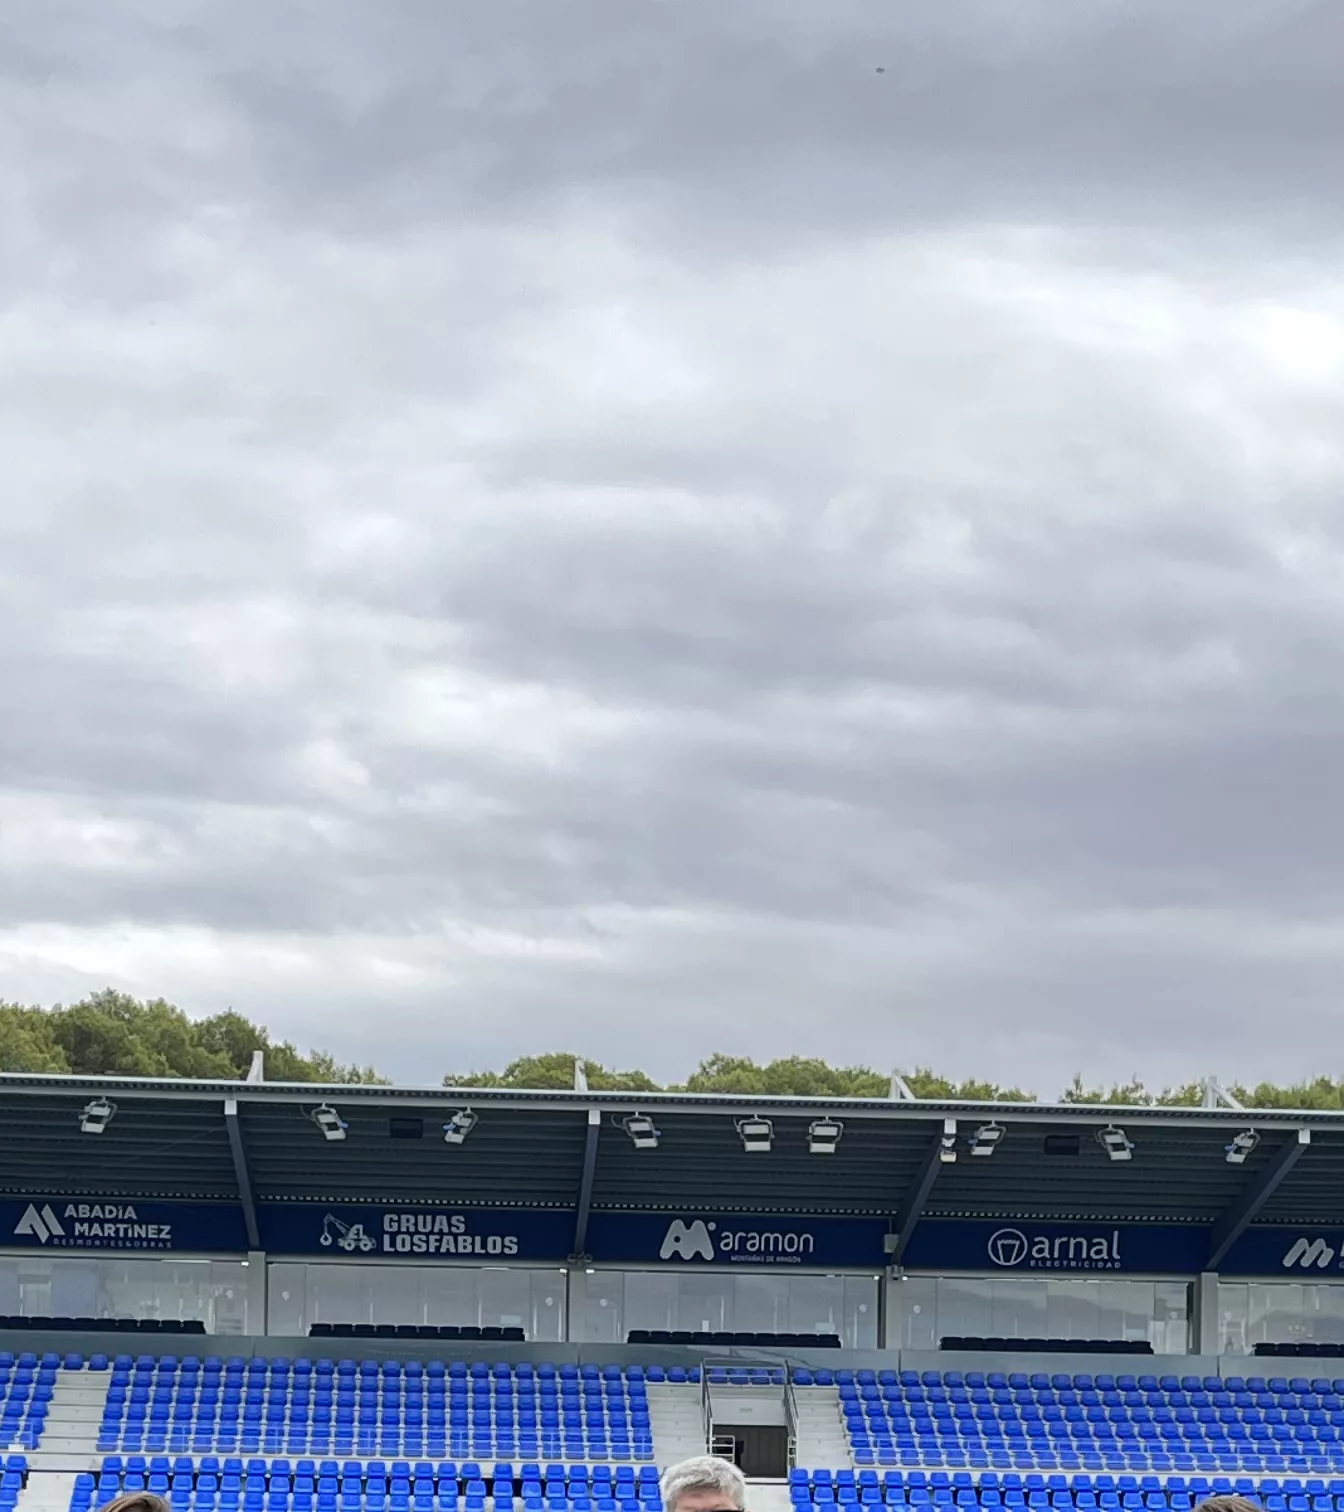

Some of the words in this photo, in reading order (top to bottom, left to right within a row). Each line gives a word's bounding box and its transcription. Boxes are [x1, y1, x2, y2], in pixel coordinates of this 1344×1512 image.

[383, 1214, 465, 1233] GRUAS
[720, 1231, 814, 1253] aramon
[1032, 1230, 1121, 1259] arnal
